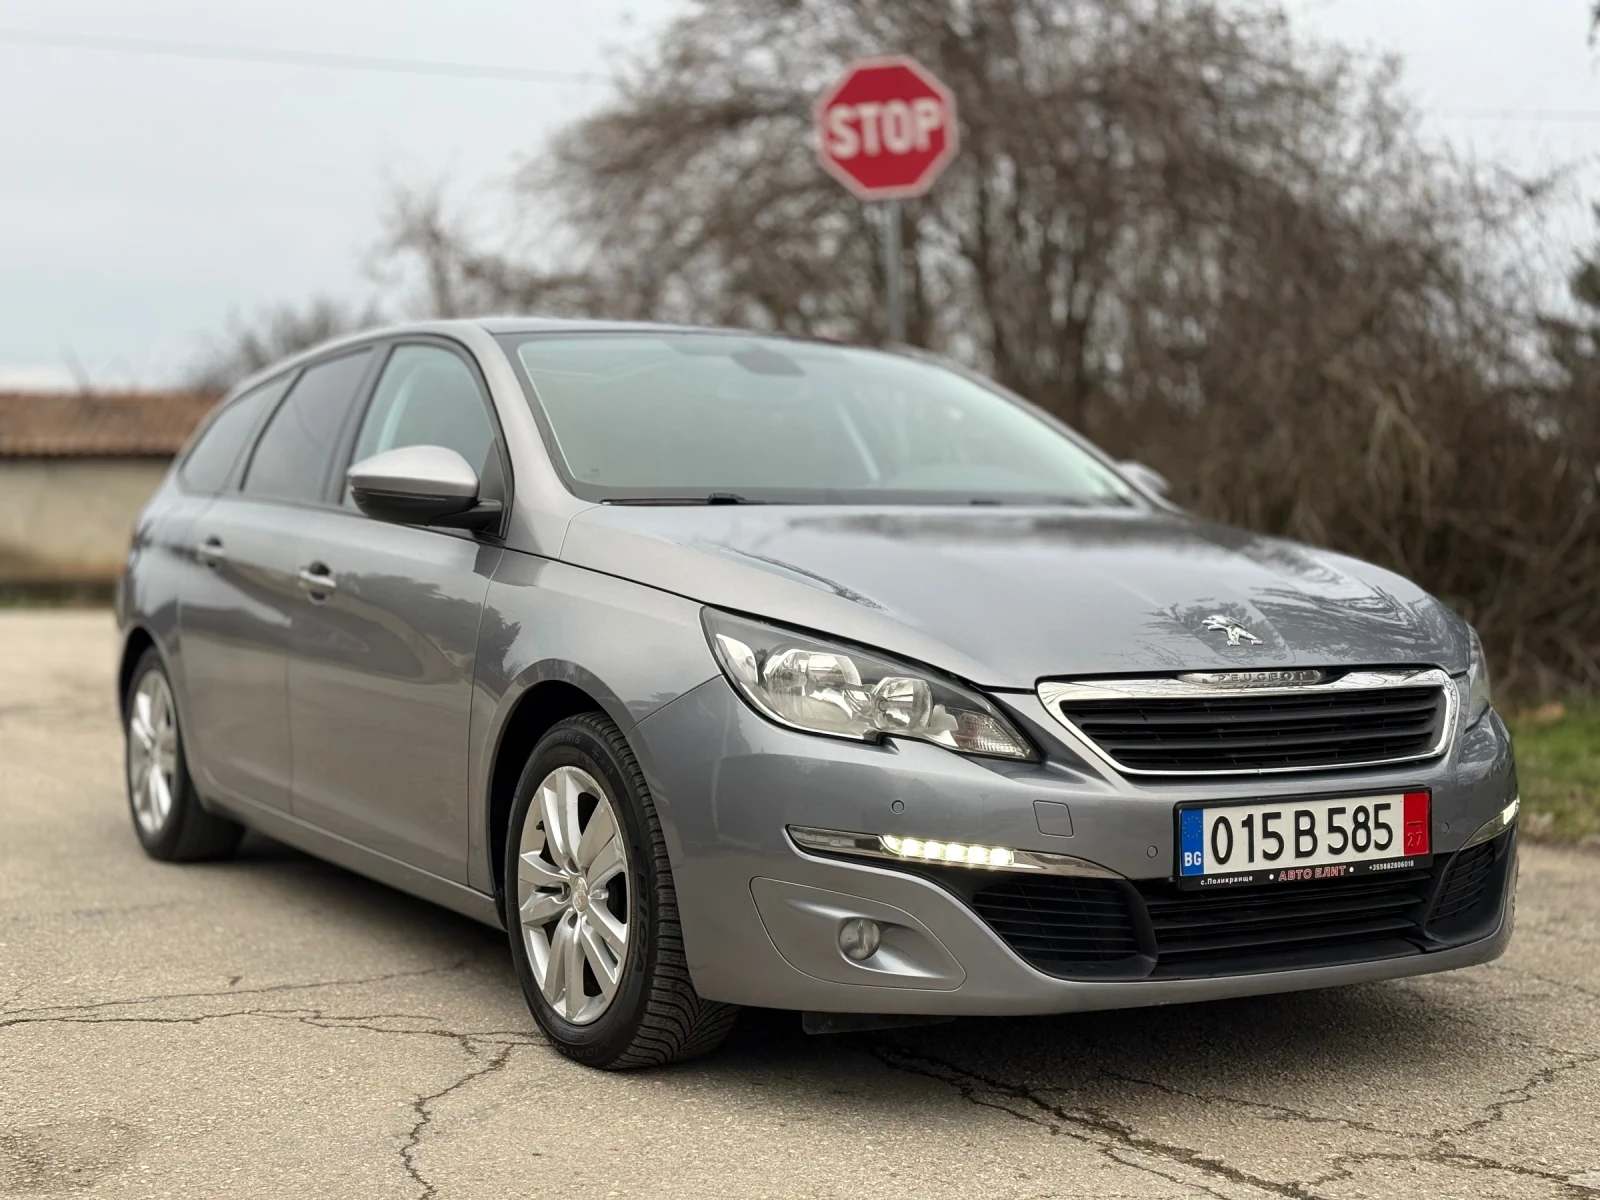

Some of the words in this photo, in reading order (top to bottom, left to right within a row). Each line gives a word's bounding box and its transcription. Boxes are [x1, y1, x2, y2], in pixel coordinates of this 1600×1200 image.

[829, 98, 941, 160] STOP
[1218, 672, 1307, 682] PEUGEOT
[1184, 851, 1202, 867] BG
[1278, 868, 1313, 881] АВТО
[1314, 865, 1347, 878] ЕЛИТ
